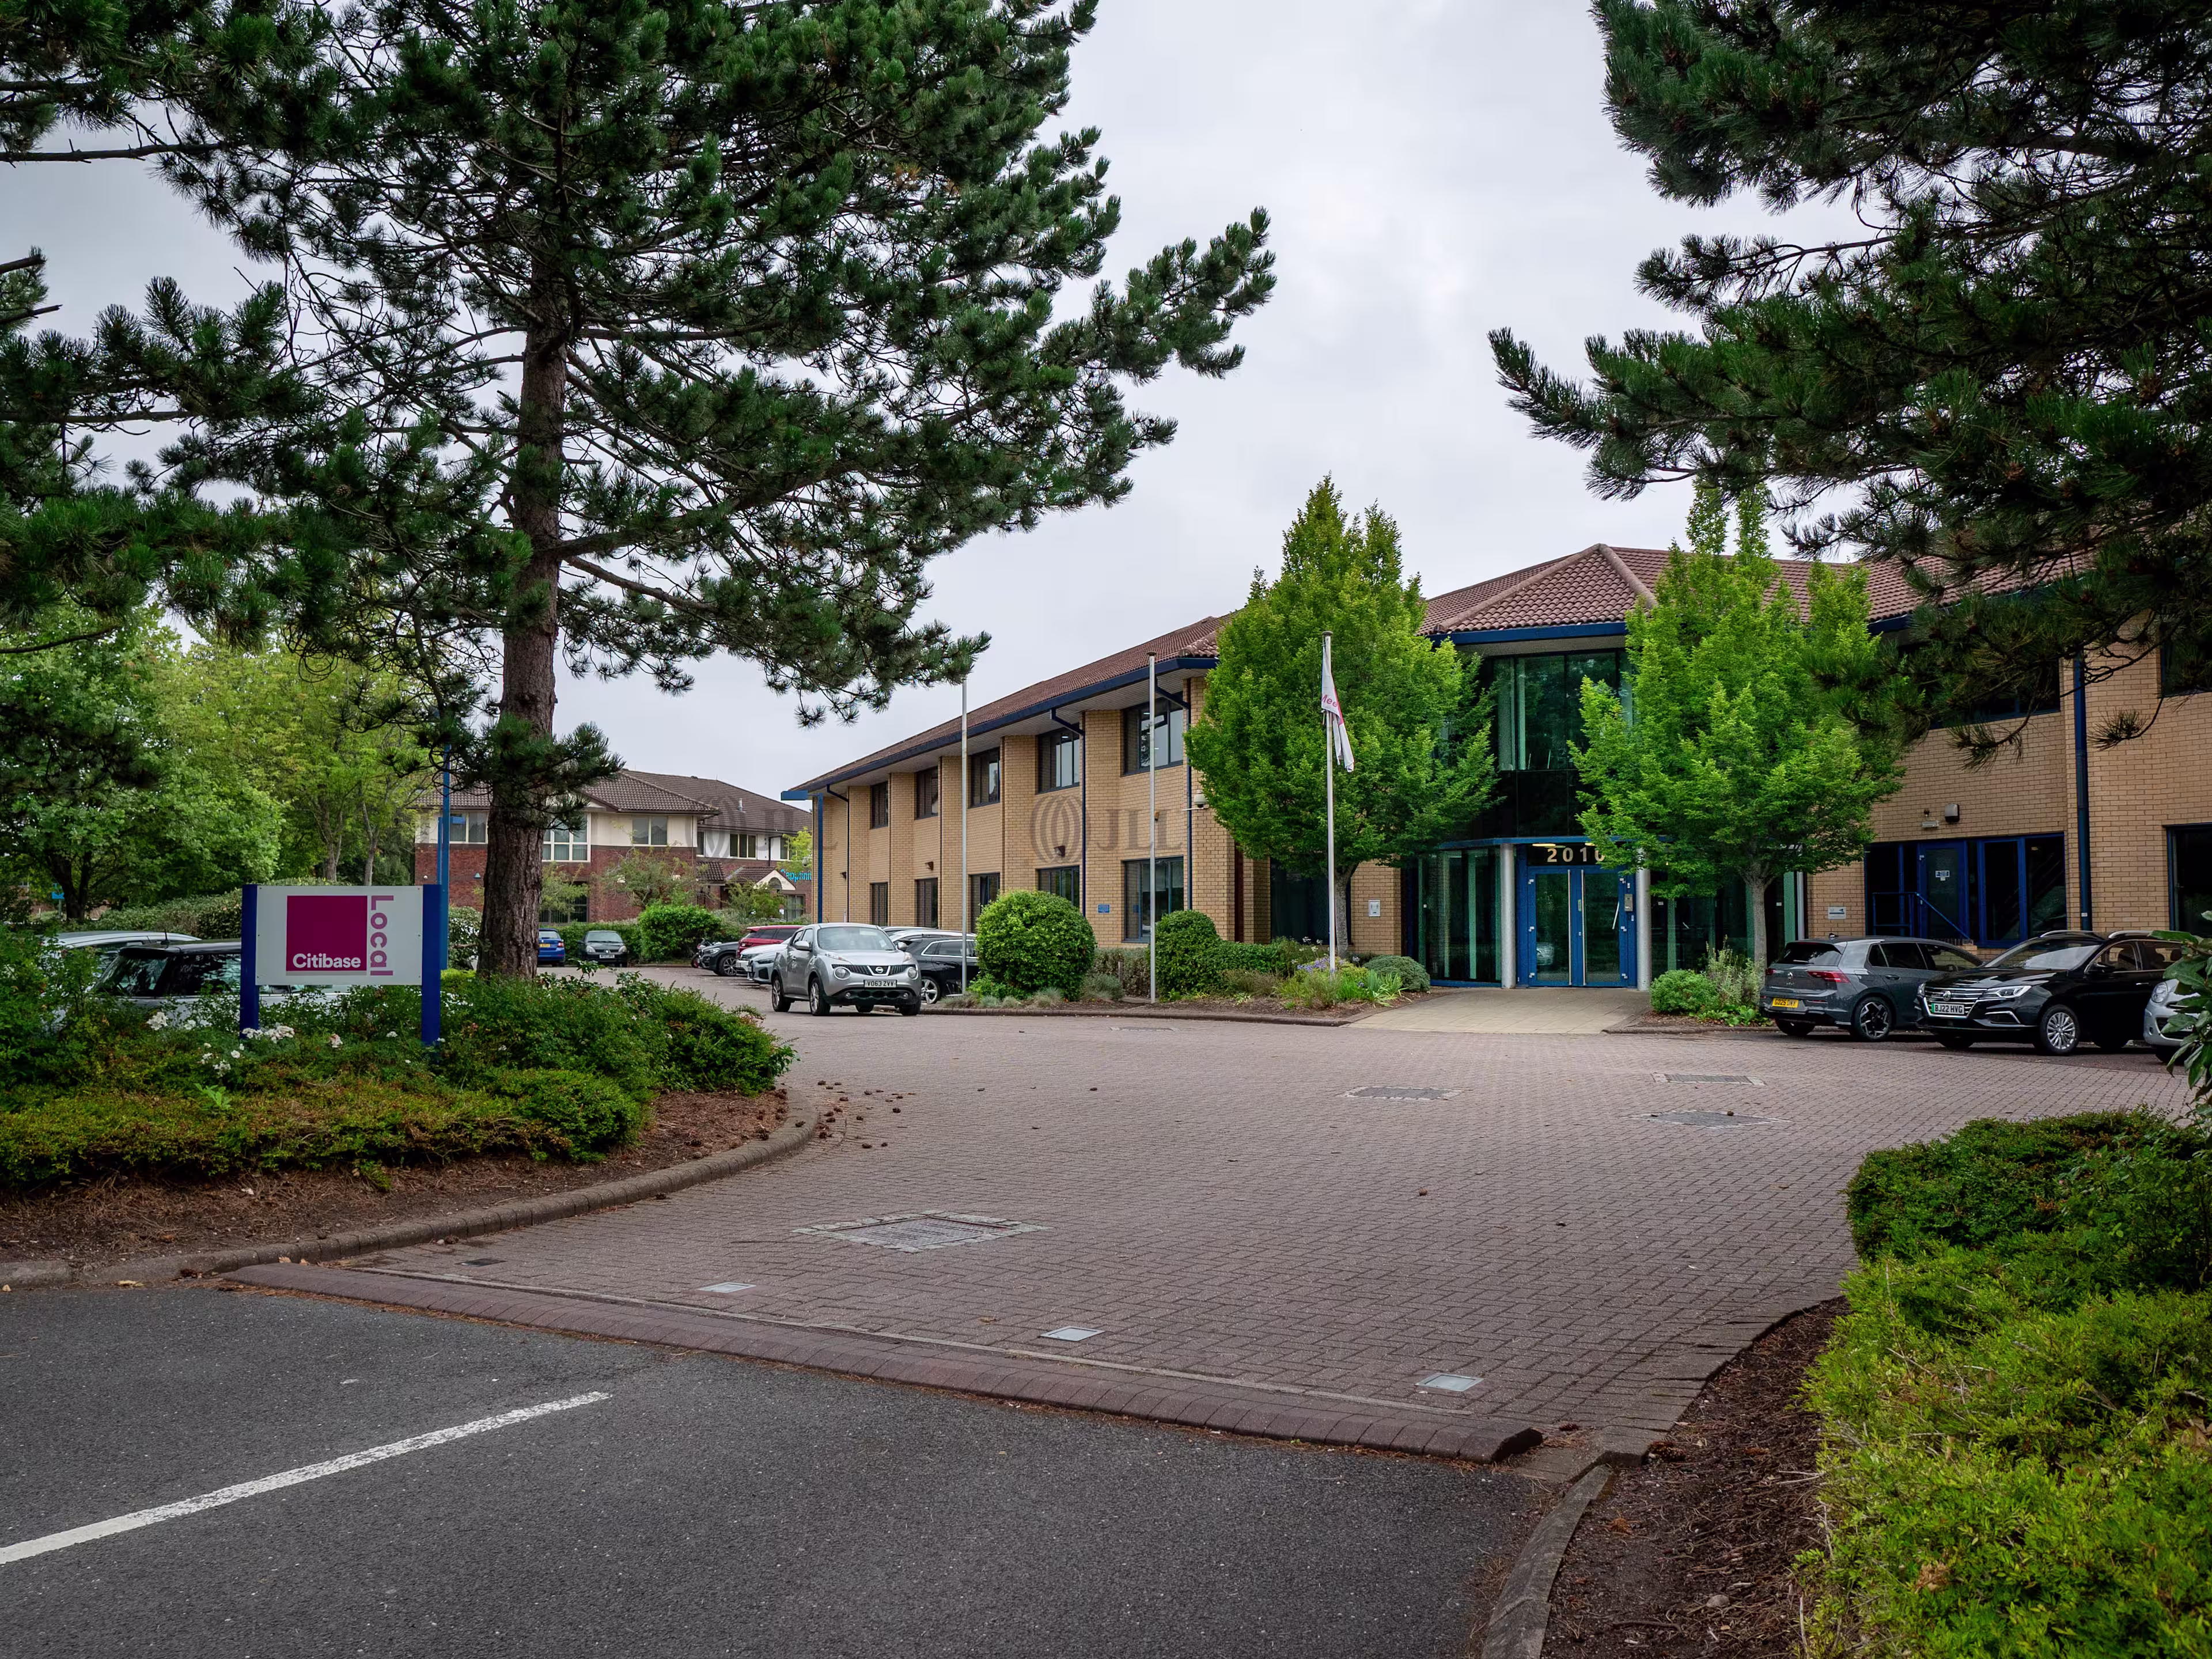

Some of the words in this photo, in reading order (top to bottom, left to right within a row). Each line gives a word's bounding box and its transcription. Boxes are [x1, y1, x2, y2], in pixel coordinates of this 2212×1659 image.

[370, 895, 394, 976] Local
[293, 953, 361, 968] Citibase
[1935, 1005, 1949, 1013] BJ22
[1950, 1005, 1963, 1013] HVG
